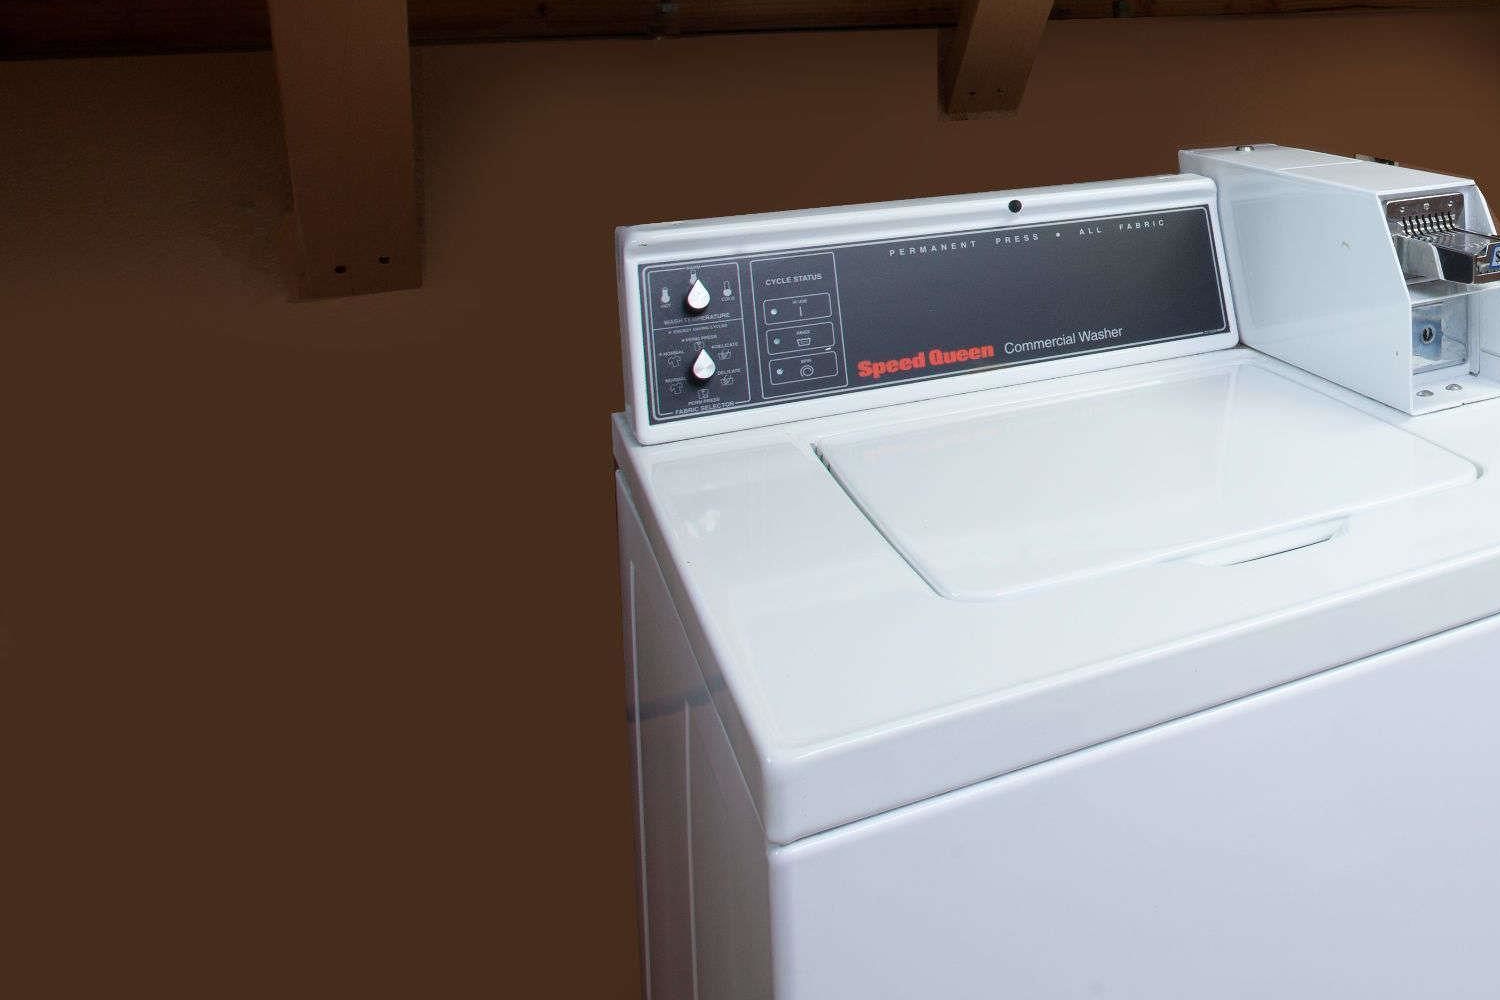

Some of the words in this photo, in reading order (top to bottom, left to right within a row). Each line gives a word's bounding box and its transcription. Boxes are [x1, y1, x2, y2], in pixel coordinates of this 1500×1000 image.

[889, 240, 977, 257] PERMANENT
[995, 232, 1040, 245] PRESS
[1078, 226, 1103, 236] ALL
[1118, 219, 1166, 232] FABRIC
[765, 276, 792, 286] CYCLE
[793, 273, 823, 283] STATUS
[857, 350, 927, 380] Speed
[929, 343, 995, 367] Queen
[1004, 332, 1077, 355] Commercial
[1078, 325, 1124, 343] Washer
[674, 406, 699, 415] FABRIC
